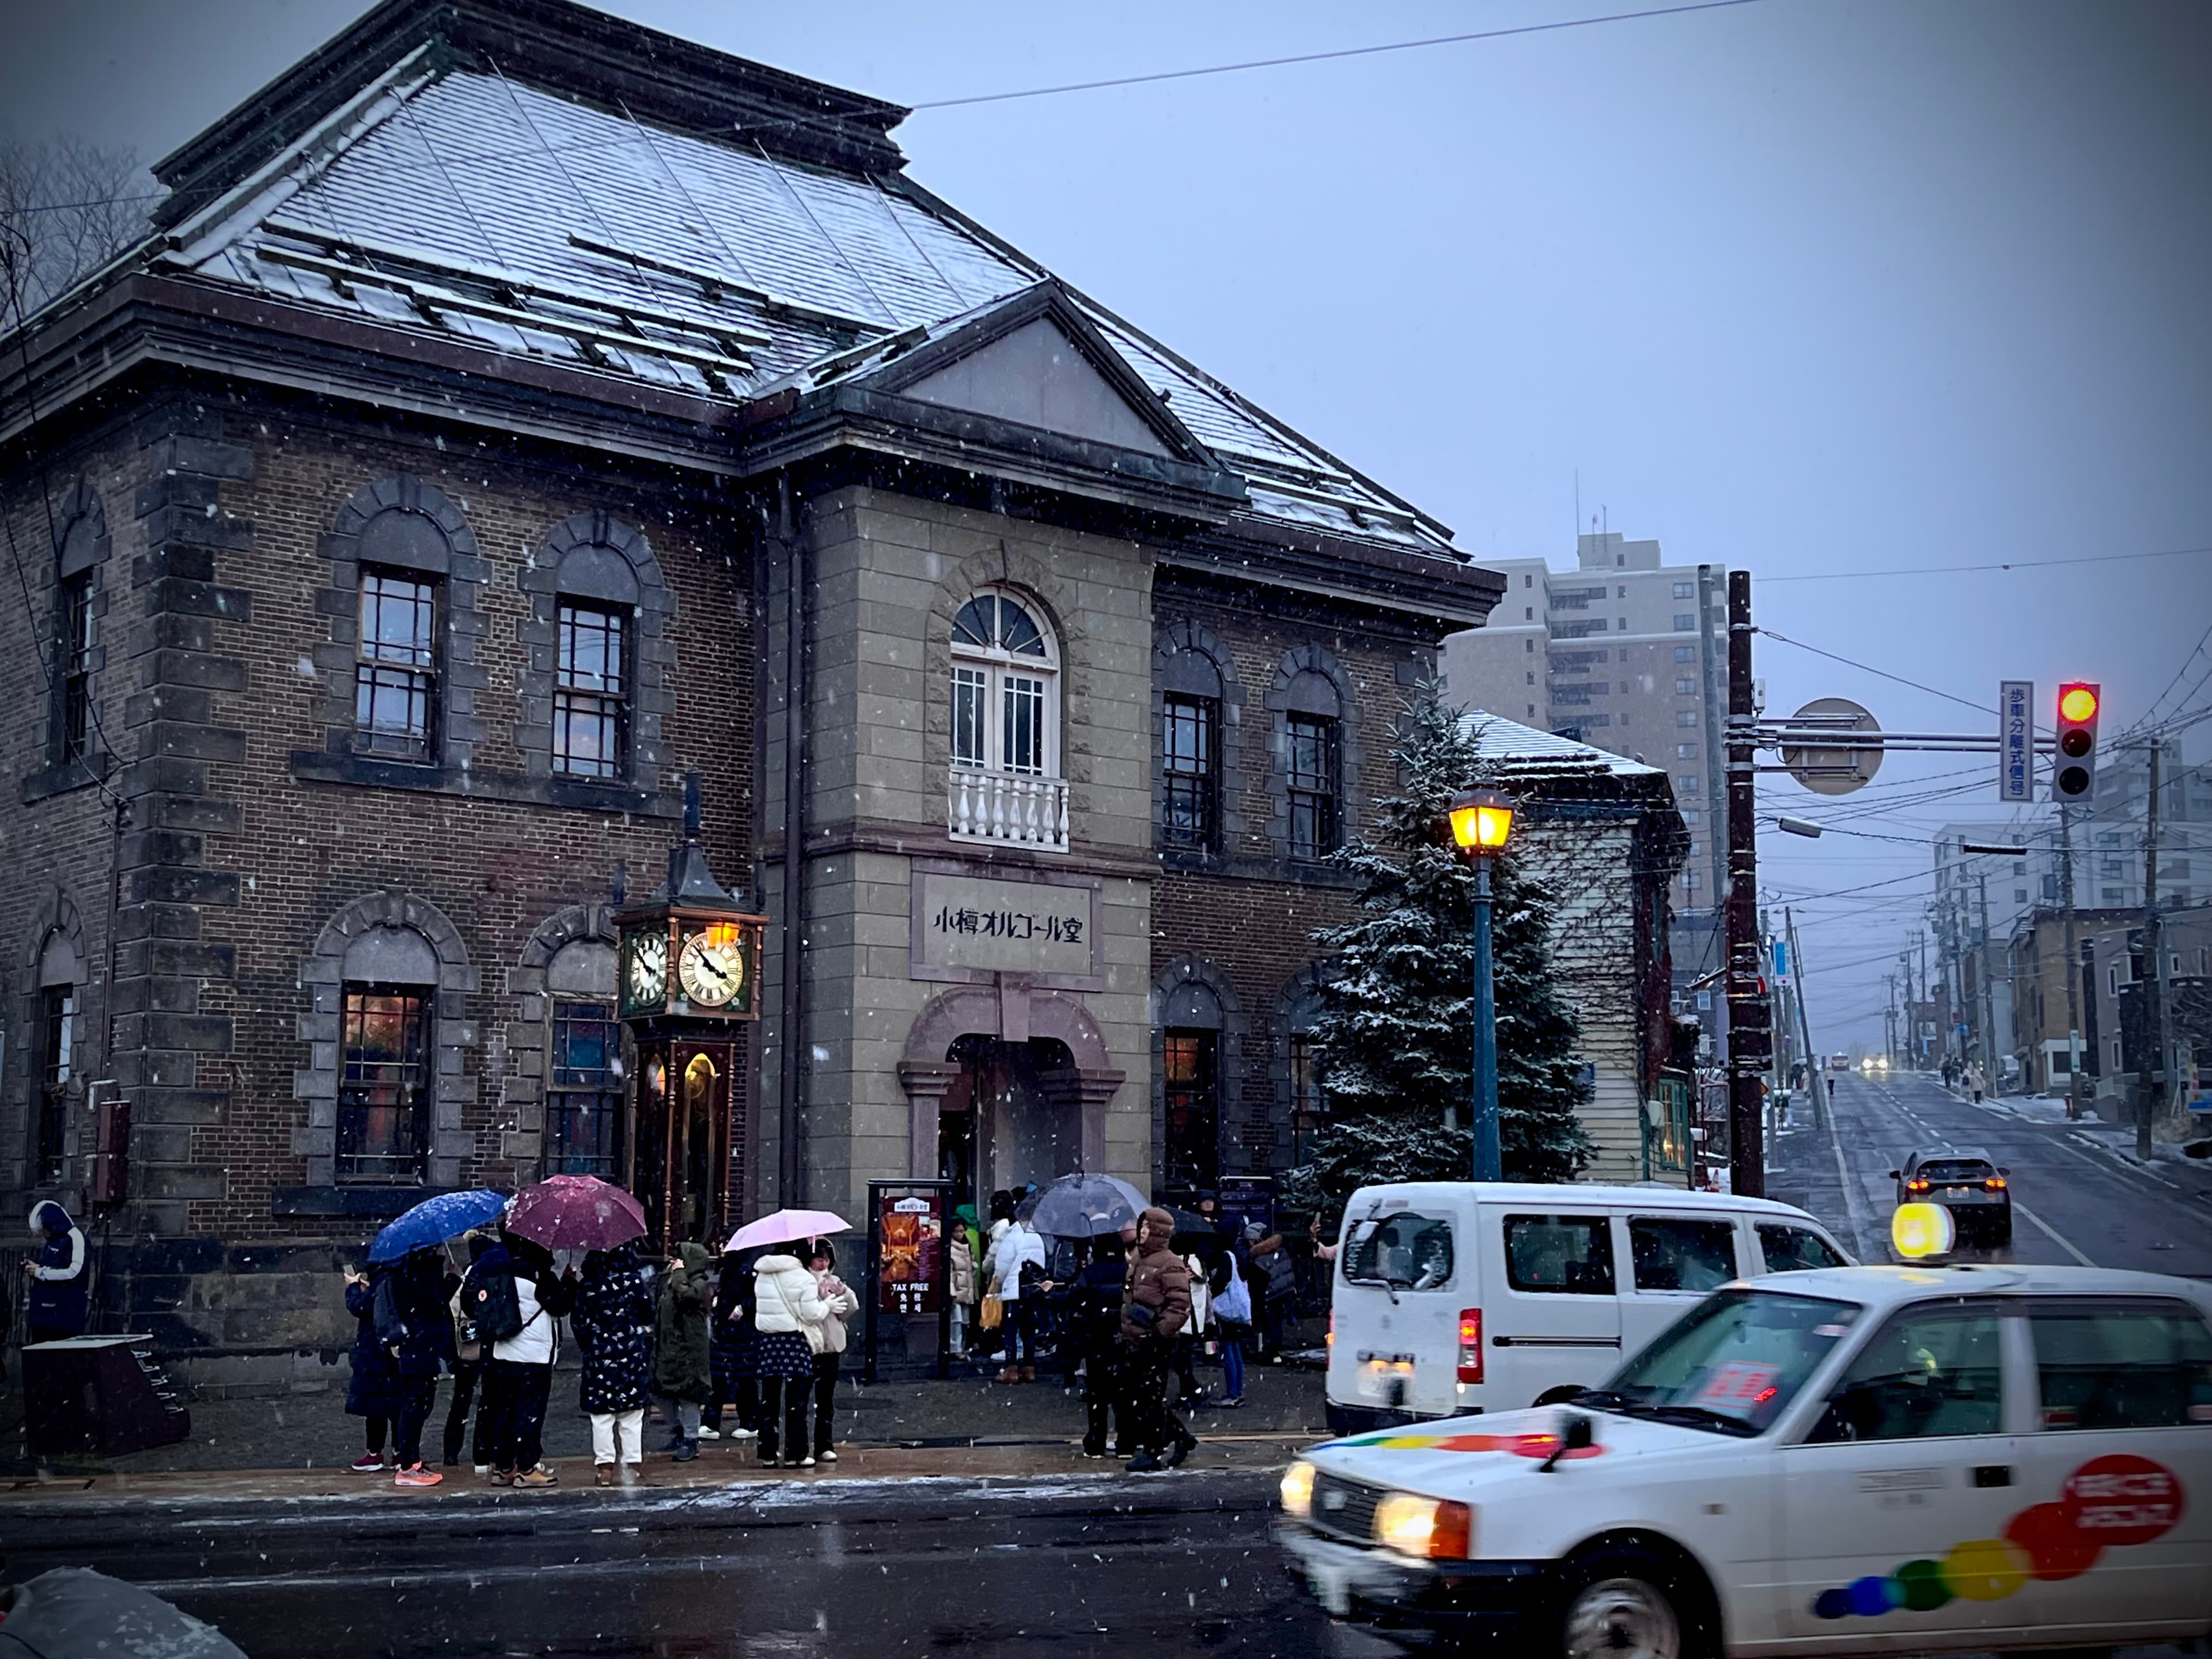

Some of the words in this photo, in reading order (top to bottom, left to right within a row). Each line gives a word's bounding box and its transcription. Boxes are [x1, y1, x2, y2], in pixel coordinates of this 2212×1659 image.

[2009, 688, 2025, 796] 歩車分離式信号
[934, 906, 1083, 944] 小樽オルゴール堂
[892, 1283, 907, 1291] TAX
[910, 1283, 929, 1291] FREE
